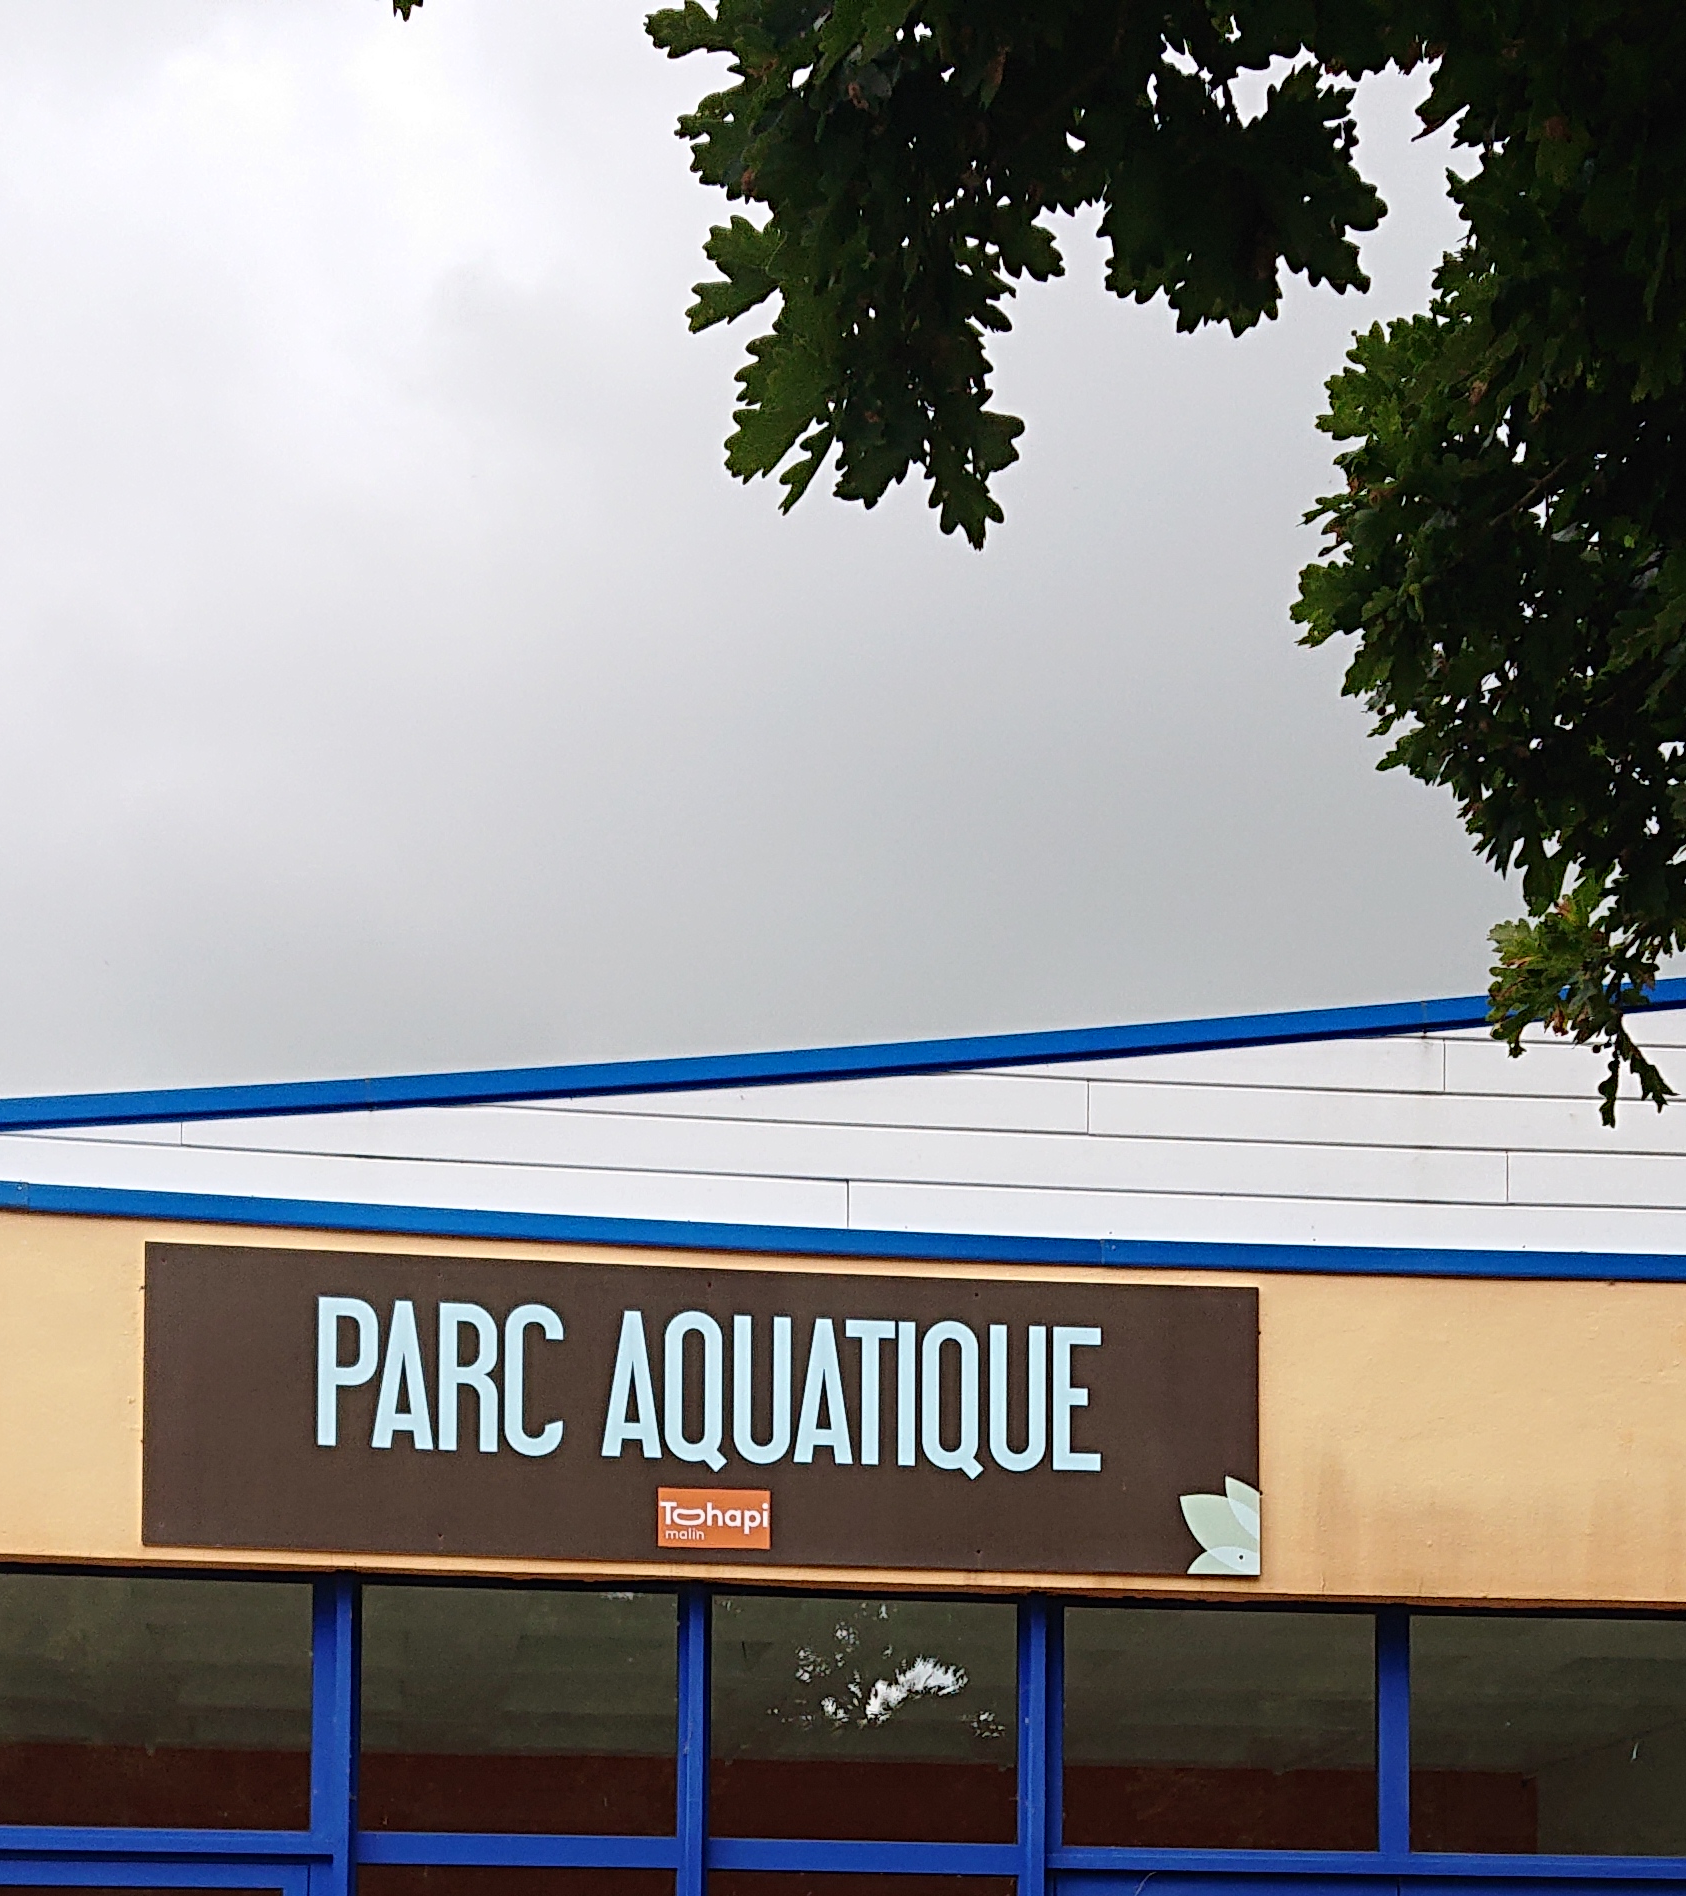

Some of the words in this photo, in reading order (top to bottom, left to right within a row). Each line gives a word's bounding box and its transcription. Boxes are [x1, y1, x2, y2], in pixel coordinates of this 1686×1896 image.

[316, 1296, 563, 1457] PARC
[601, 1309, 1102, 1481] AQUATIQUE
[665, 1528, 705, 1541] malin
